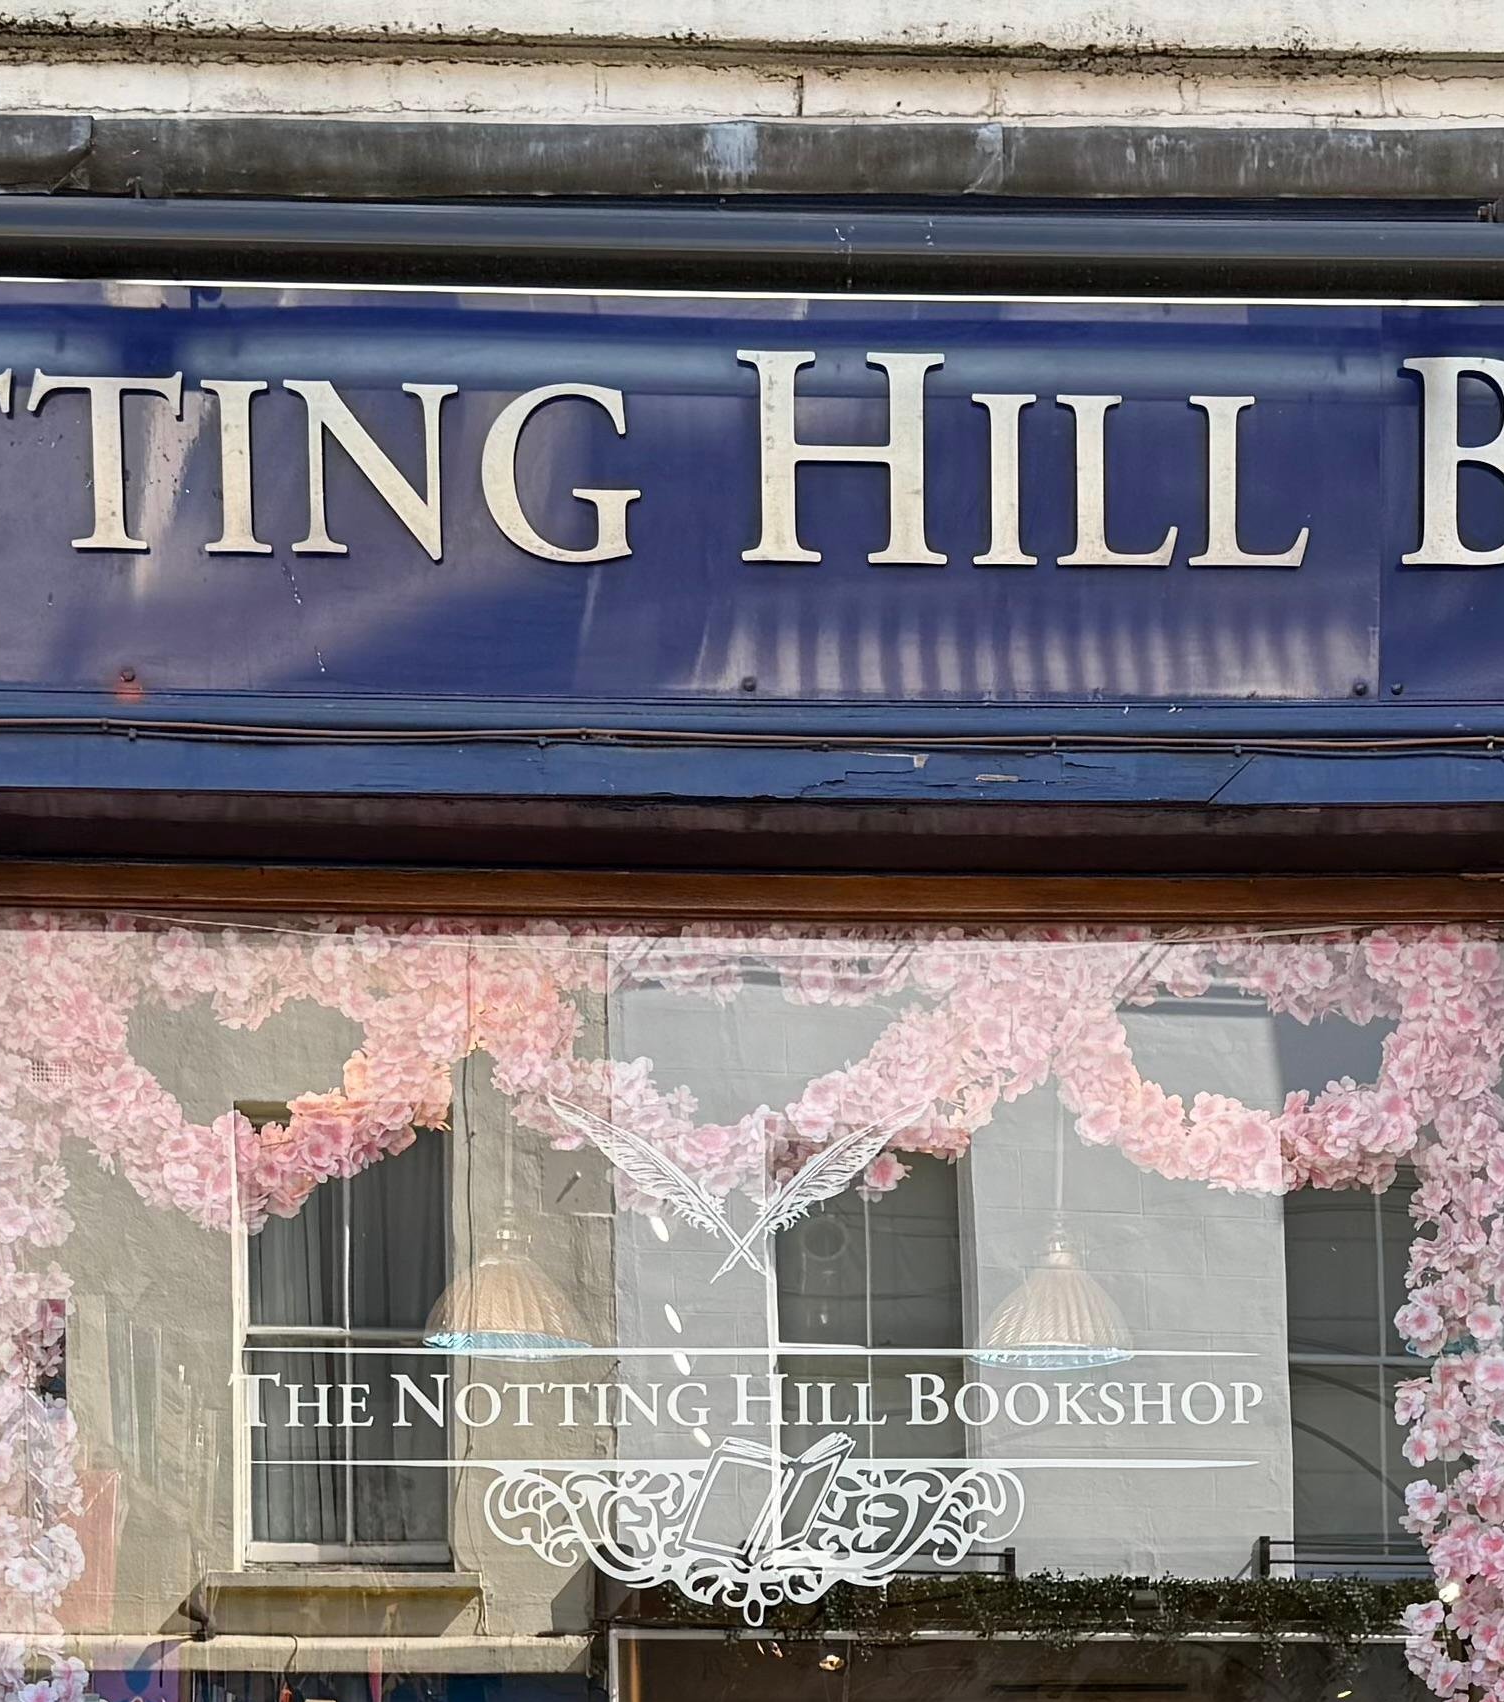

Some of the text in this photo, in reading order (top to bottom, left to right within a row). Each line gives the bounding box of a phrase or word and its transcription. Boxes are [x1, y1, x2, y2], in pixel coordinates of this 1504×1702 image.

[737, 349, 1309, 566] HILL
[228, 1372, 1264, 1429] THE NOTTING HILL BOOKSHOP
